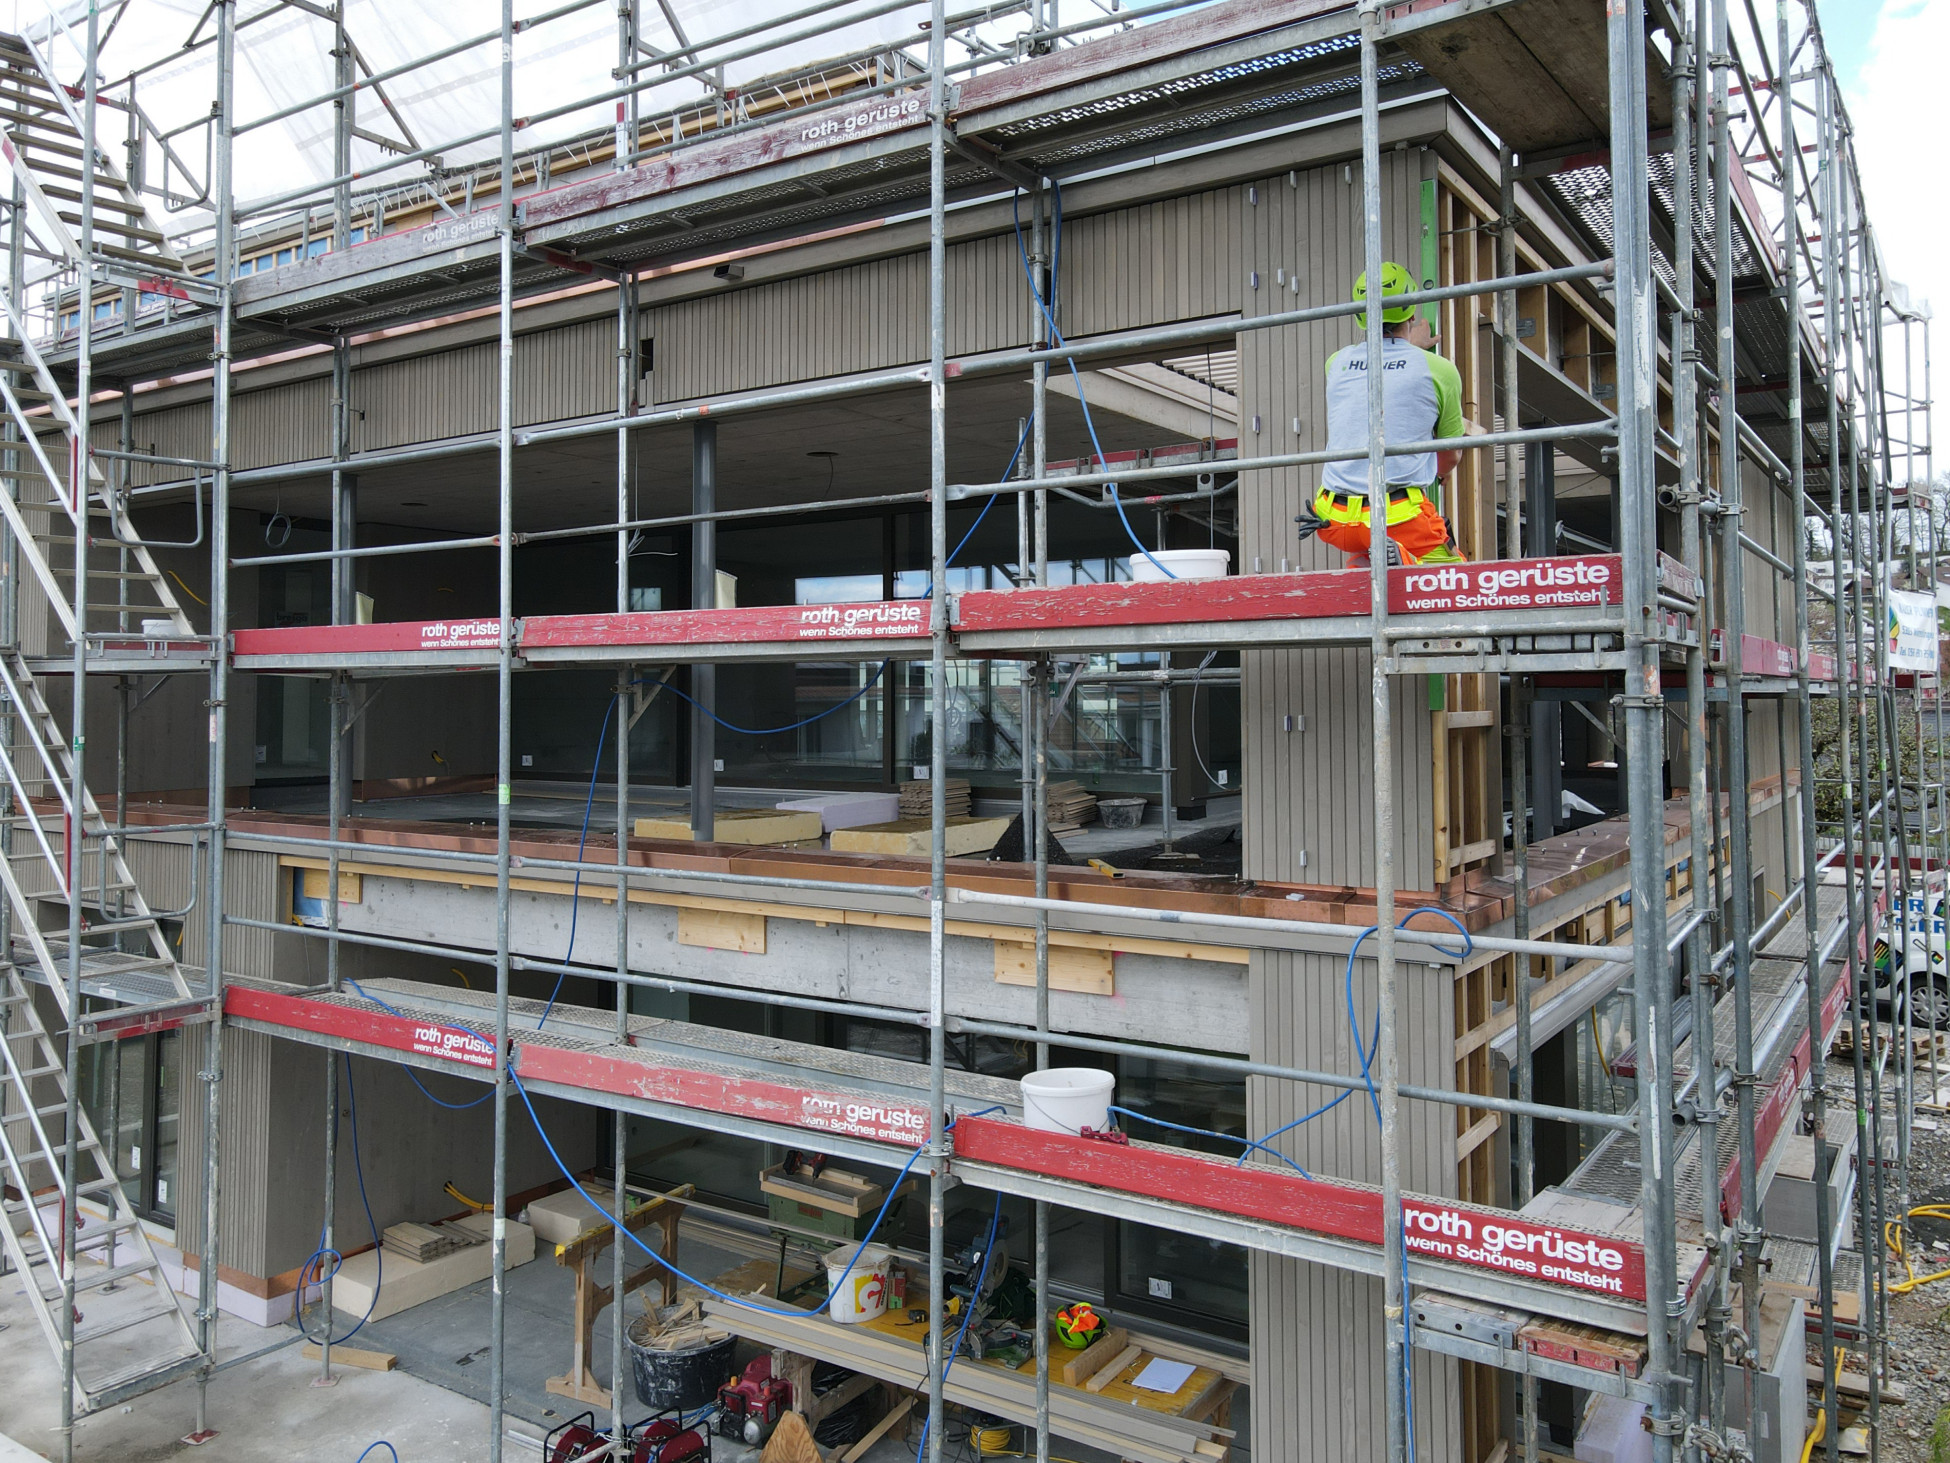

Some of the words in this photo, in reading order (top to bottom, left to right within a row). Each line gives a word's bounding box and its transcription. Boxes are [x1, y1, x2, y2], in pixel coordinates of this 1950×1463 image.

[801, 120, 838, 141] roth
[844, 100, 920, 132] gerüste
[800, 140, 826, 152] wenn
[422, 226, 447, 244] roth
[1348, 360, 1407, 371] HUNER
[1405, 568, 1469, 592] roth
[1477, 561, 1610, 594] gerüste
[1406, 598, 1451, 609] wenn
[1455, 593, 1531, 608] Schönes
[801, 607, 840, 624] roth
[844, 604, 921, 627] gerüste
[422, 623, 447, 637] roth
[450, 621, 500, 640] gerüste
[799, 628, 826, 636] wenn
[828, 626, 872, 637] Schönes
[875, 624, 919, 635] entsteht
[415, 1027, 441, 1044] roth
[413, 1043, 432, 1053] wenn
[463, 1054, 493, 1066] entsteht
[830, 1118, 876, 1136] Schönes
[878, 1129, 923, 1144] entsteht
[1404, 1208, 1472, 1240] roth
[1482, 1224, 1623, 1271] gerüste
[1404, 1235, 1452, 1255] wenn
[1456, 1243, 1537, 1273] Schönes
[1541, 1263, 1623, 1292] entsteht
